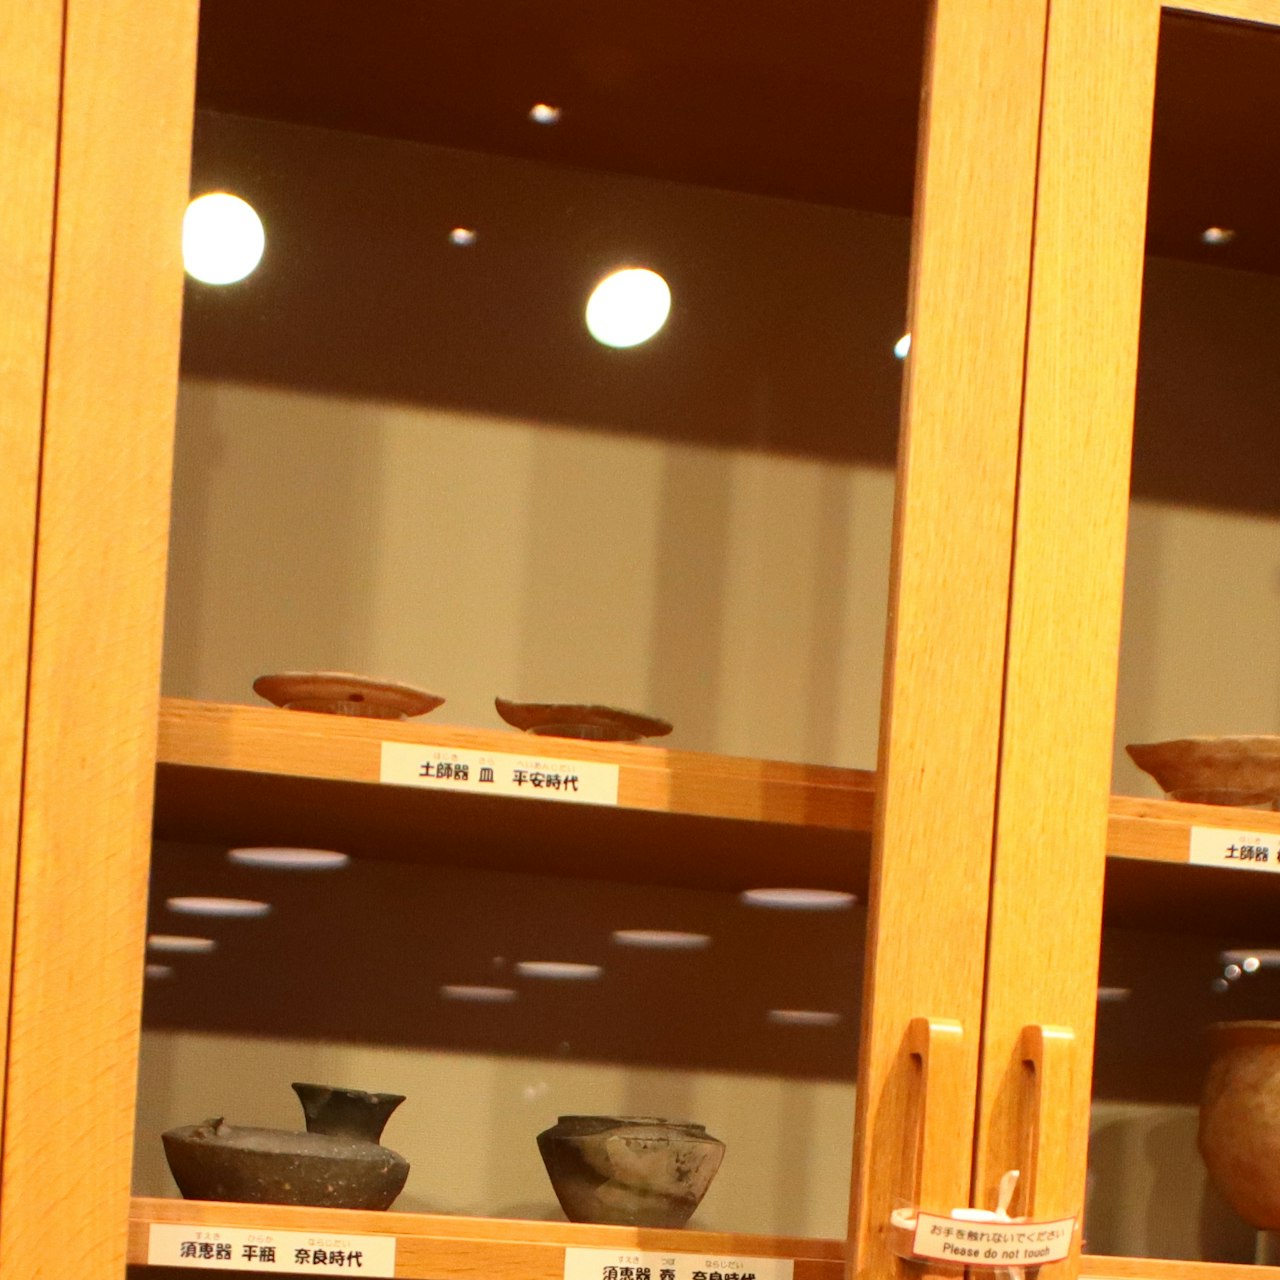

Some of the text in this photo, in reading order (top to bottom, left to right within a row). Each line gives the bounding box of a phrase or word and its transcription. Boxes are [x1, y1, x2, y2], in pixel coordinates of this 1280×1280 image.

[419, 761, 579, 792] 土師器 皿 平安時代
[1224, 844, 1270, 863] 土師器
[930, 1224, 1066, 1245] お手を触れないでください
[180, 1241, 363, 1268] 須恵器 平瓶 奈良時代
[943, 1242, 1051, 1260] Please do not touch
